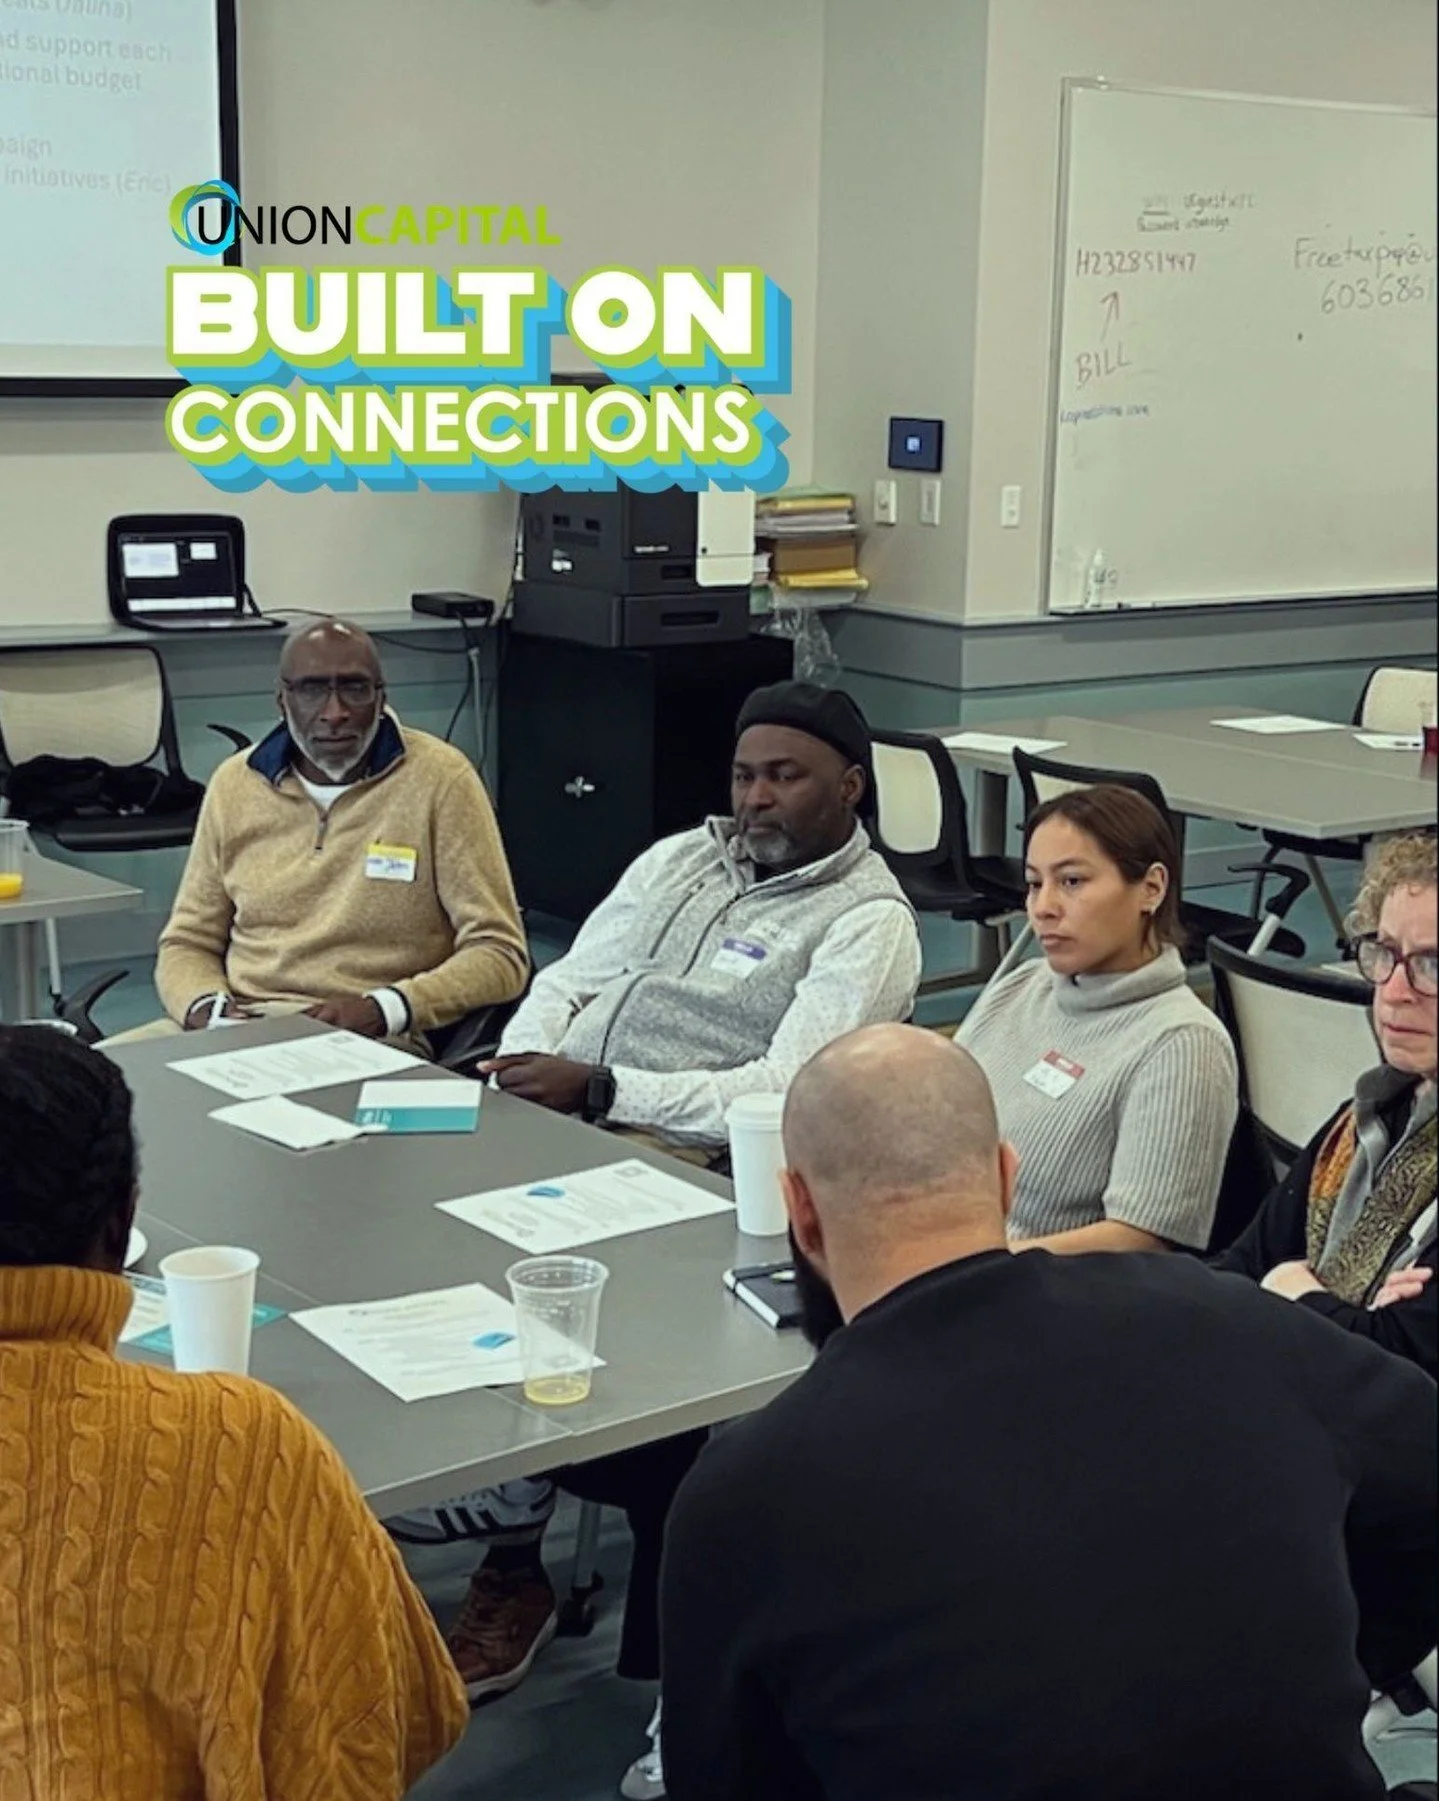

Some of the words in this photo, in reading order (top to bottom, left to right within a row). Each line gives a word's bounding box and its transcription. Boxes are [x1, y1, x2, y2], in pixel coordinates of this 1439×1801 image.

[26, 33, 113, 61] support
[118, 42, 172, 63] each
[66, 66, 142, 94] budget
[1076, 340, 1133, 388] BILL
